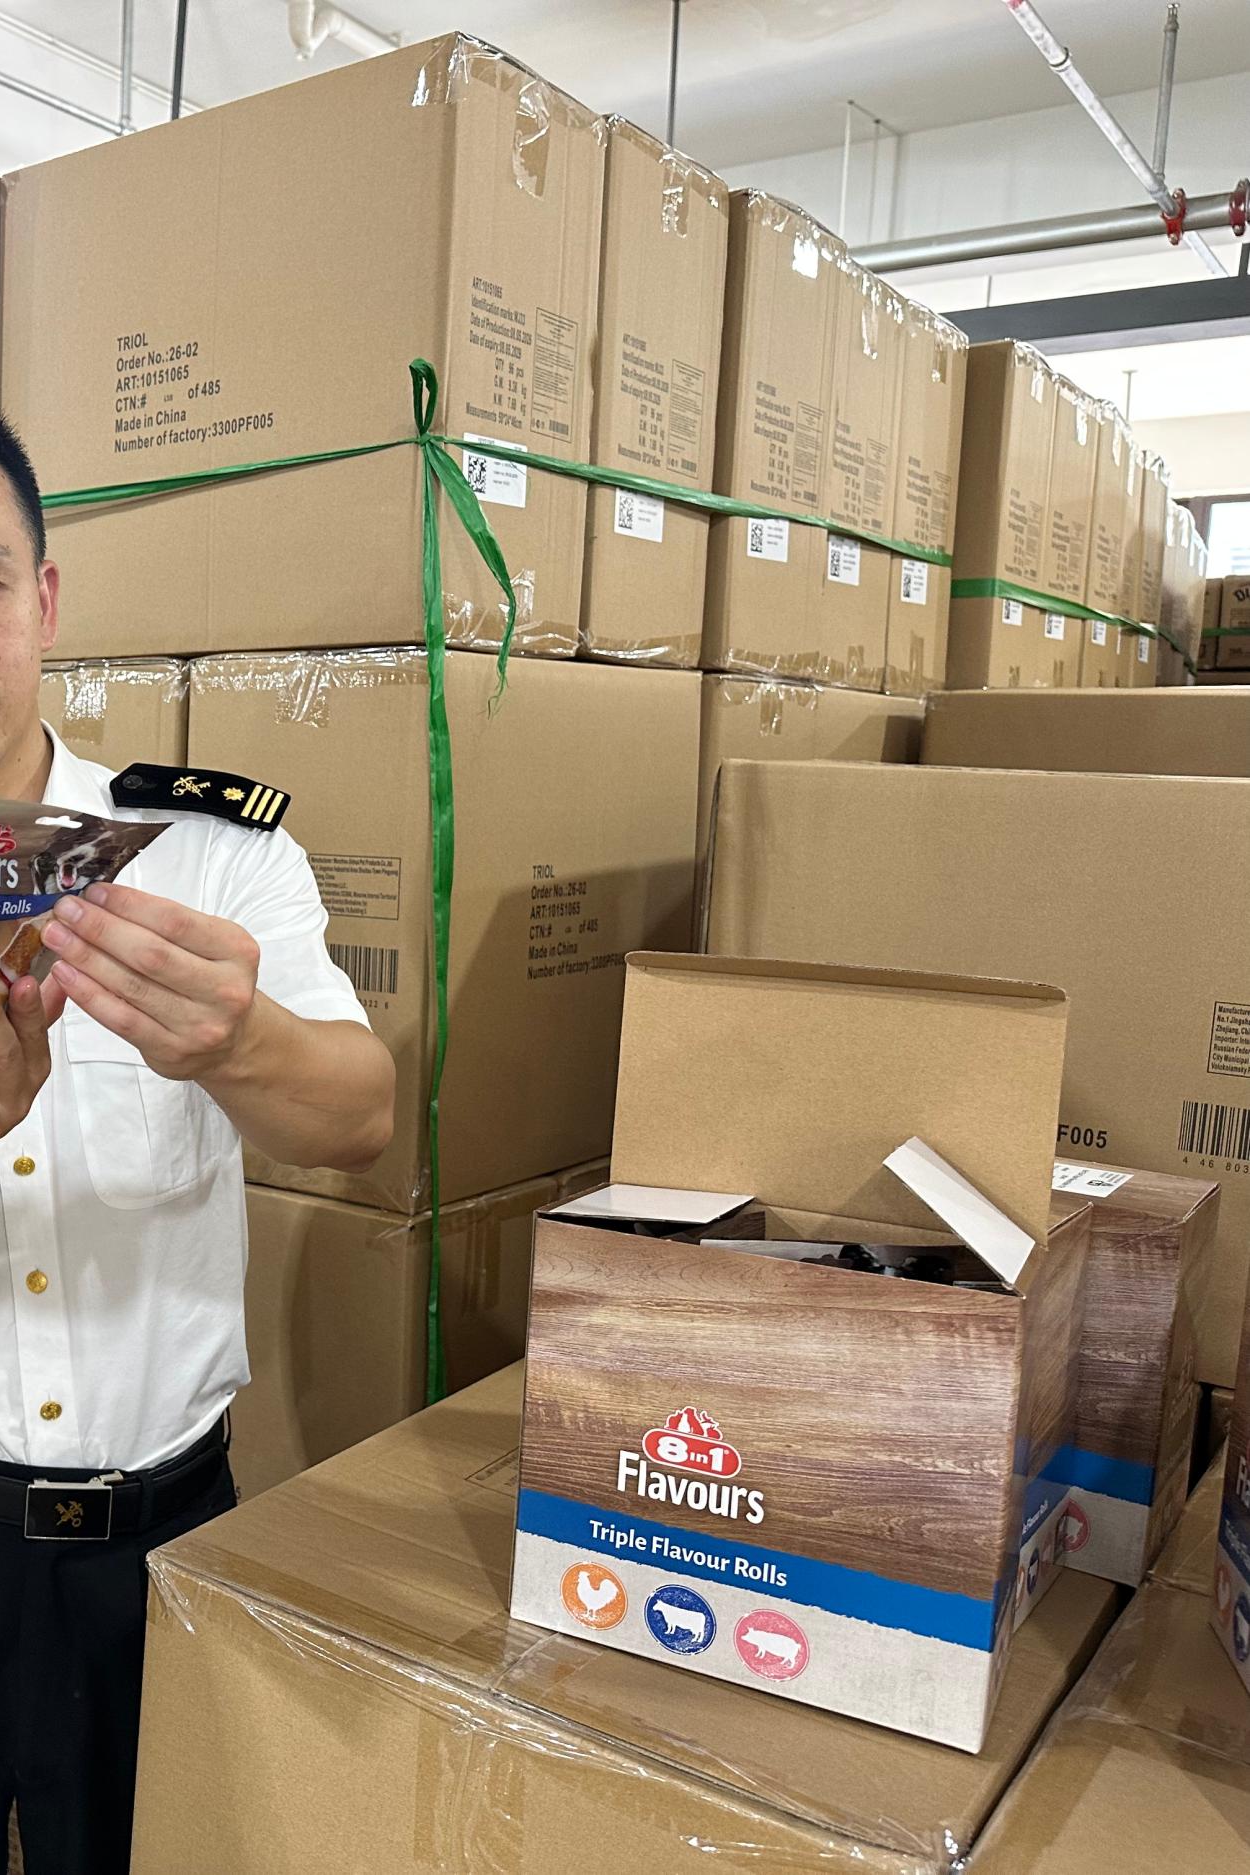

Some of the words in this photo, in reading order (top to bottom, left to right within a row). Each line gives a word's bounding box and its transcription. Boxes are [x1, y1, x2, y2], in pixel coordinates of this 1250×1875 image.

[117, 332, 149, 352] TRIOL
[116, 355, 146, 373] Order
[147, 342, 199, 366] No.:26-02
[116, 365, 190, 393] ART:10151065
[115, 393, 147, 413] CTN:#
[188, 383, 199, 400] of
[201, 379, 221, 397] 485
[115, 418, 141, 433] Made
[144, 413, 153, 428] in
[156, 409, 187, 426] China
[114, 434, 154, 453] Number
[156, 429, 168, 446] of
[169, 412, 274, 444] factory:3300PF005
[532, 864, 555, 880] TRIOL
[531, 884, 553, 900] Order
[1, 899, 32, 915] Rolls
[578, 919, 587, 934] of
[528, 944, 548, 960] Made
[556, 941, 578, 956] China
[527, 964, 556, 980] Number
[556, 961, 565, 976] of
[1056, 1124, 1108, 1149] F005
[1182, 1156, 1188, 1165] 4
[1199, 1158, 1214, 1169] 46
[1225, 1162, 1250, 1174] 803
[617, 1450, 765, 1525] Flavours
[589, 1519, 647, 1553] Triple
[651, 1535, 731, 1573] Flavour
[733, 1558, 788, 1588] Rolls
